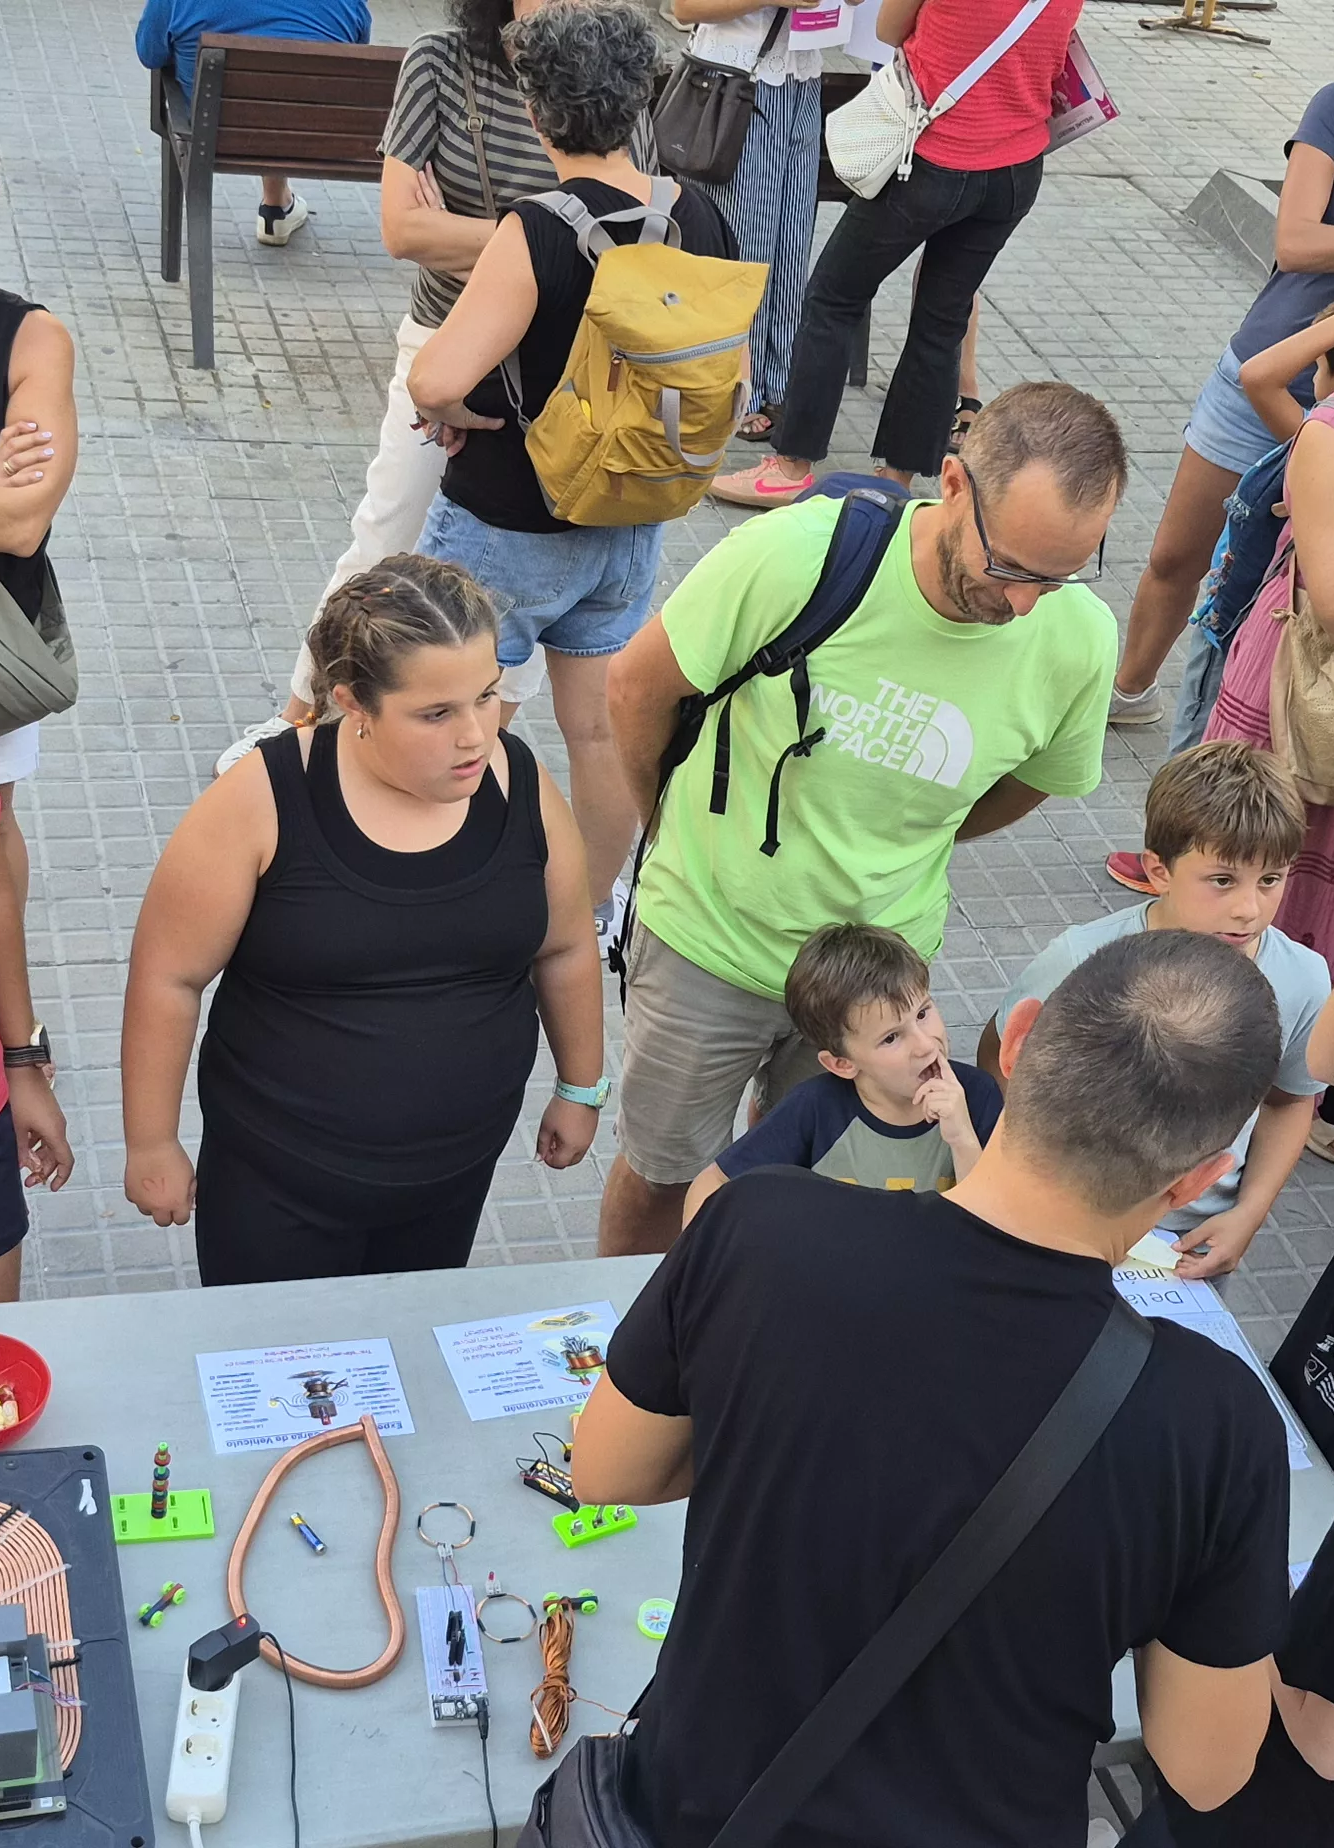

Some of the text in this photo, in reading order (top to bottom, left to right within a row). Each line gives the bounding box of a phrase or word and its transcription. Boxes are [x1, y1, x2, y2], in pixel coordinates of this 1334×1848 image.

[810, 683, 926, 747] NORTH
[873, 677, 938, 722] THE
[823, 721, 911, 770] FACE
[1124, 1291, 1183, 1307] De la
